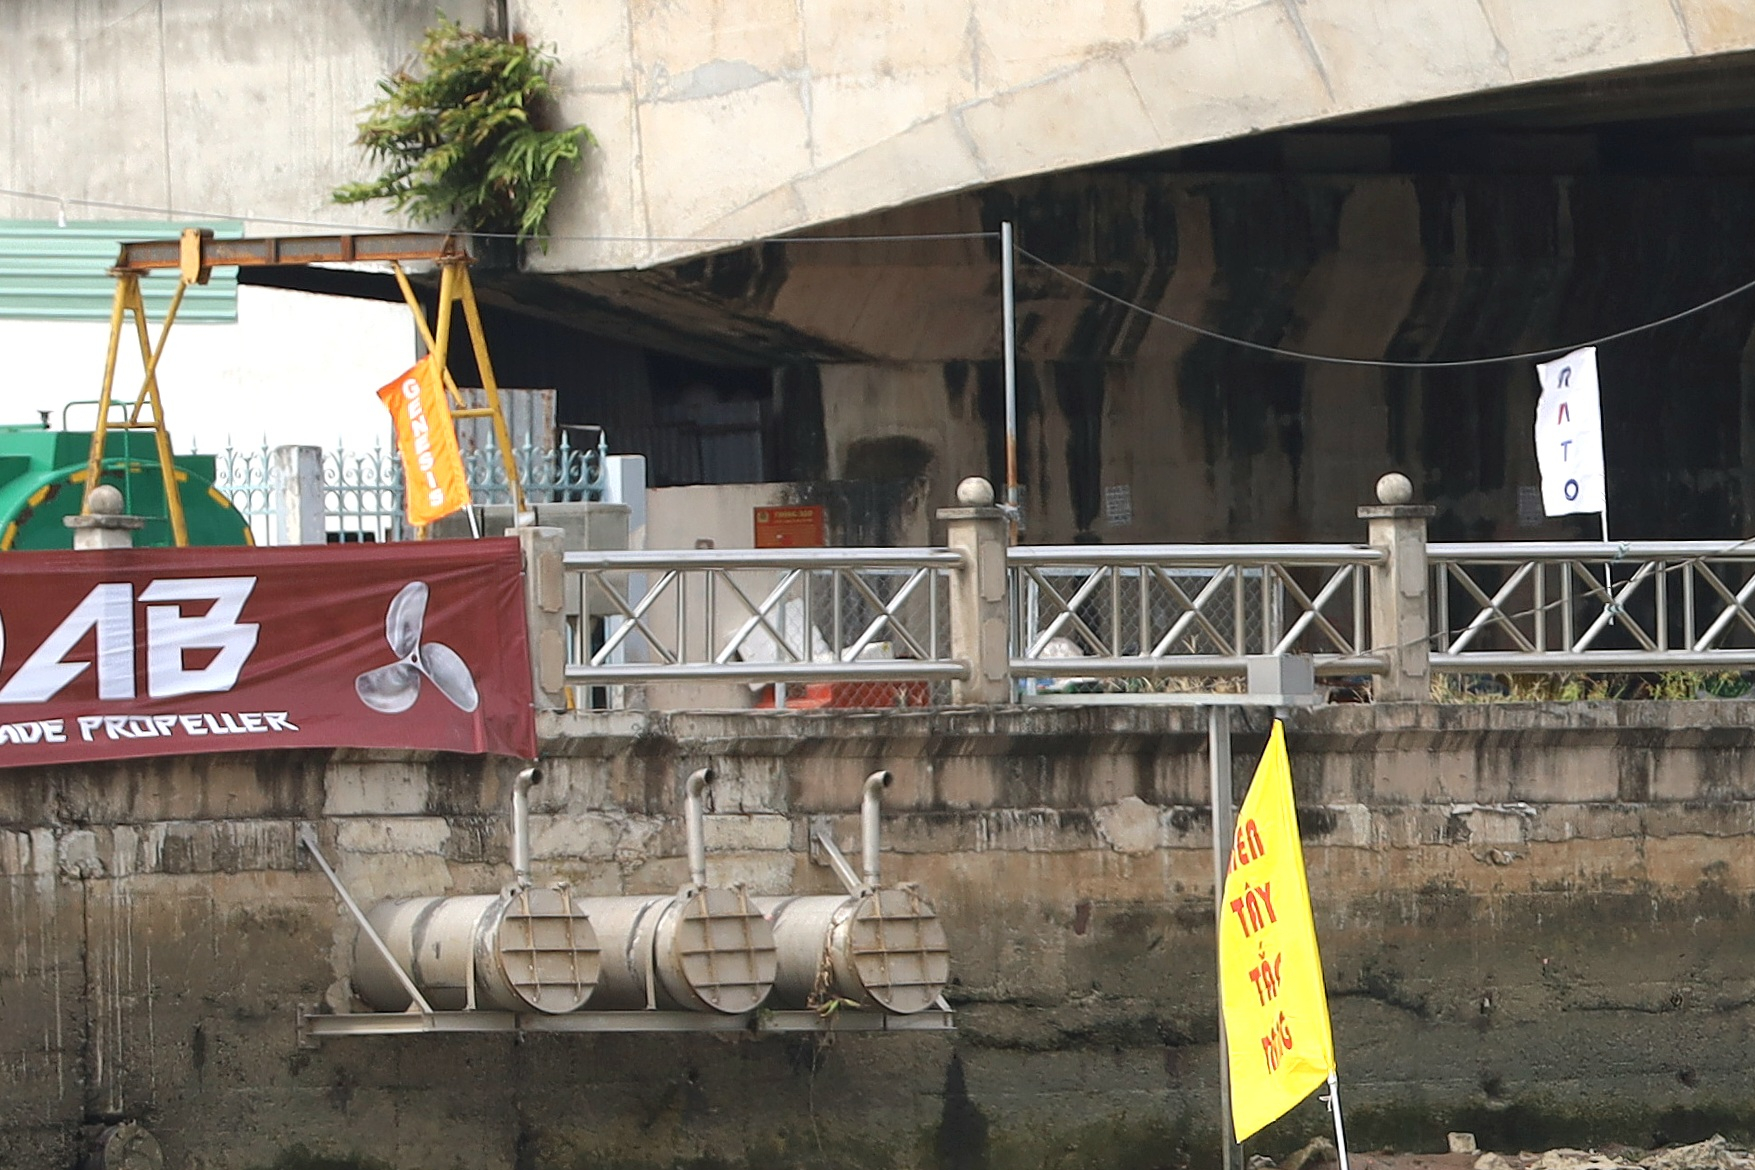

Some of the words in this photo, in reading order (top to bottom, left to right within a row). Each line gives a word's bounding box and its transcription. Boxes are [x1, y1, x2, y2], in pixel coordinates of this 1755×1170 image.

[402, 378, 444, 507] GENESIS
[0, 576, 260, 702] AB
[77, 711, 299, 742] PROPELLER
[1230, 882, 1277, 938] TÂY
